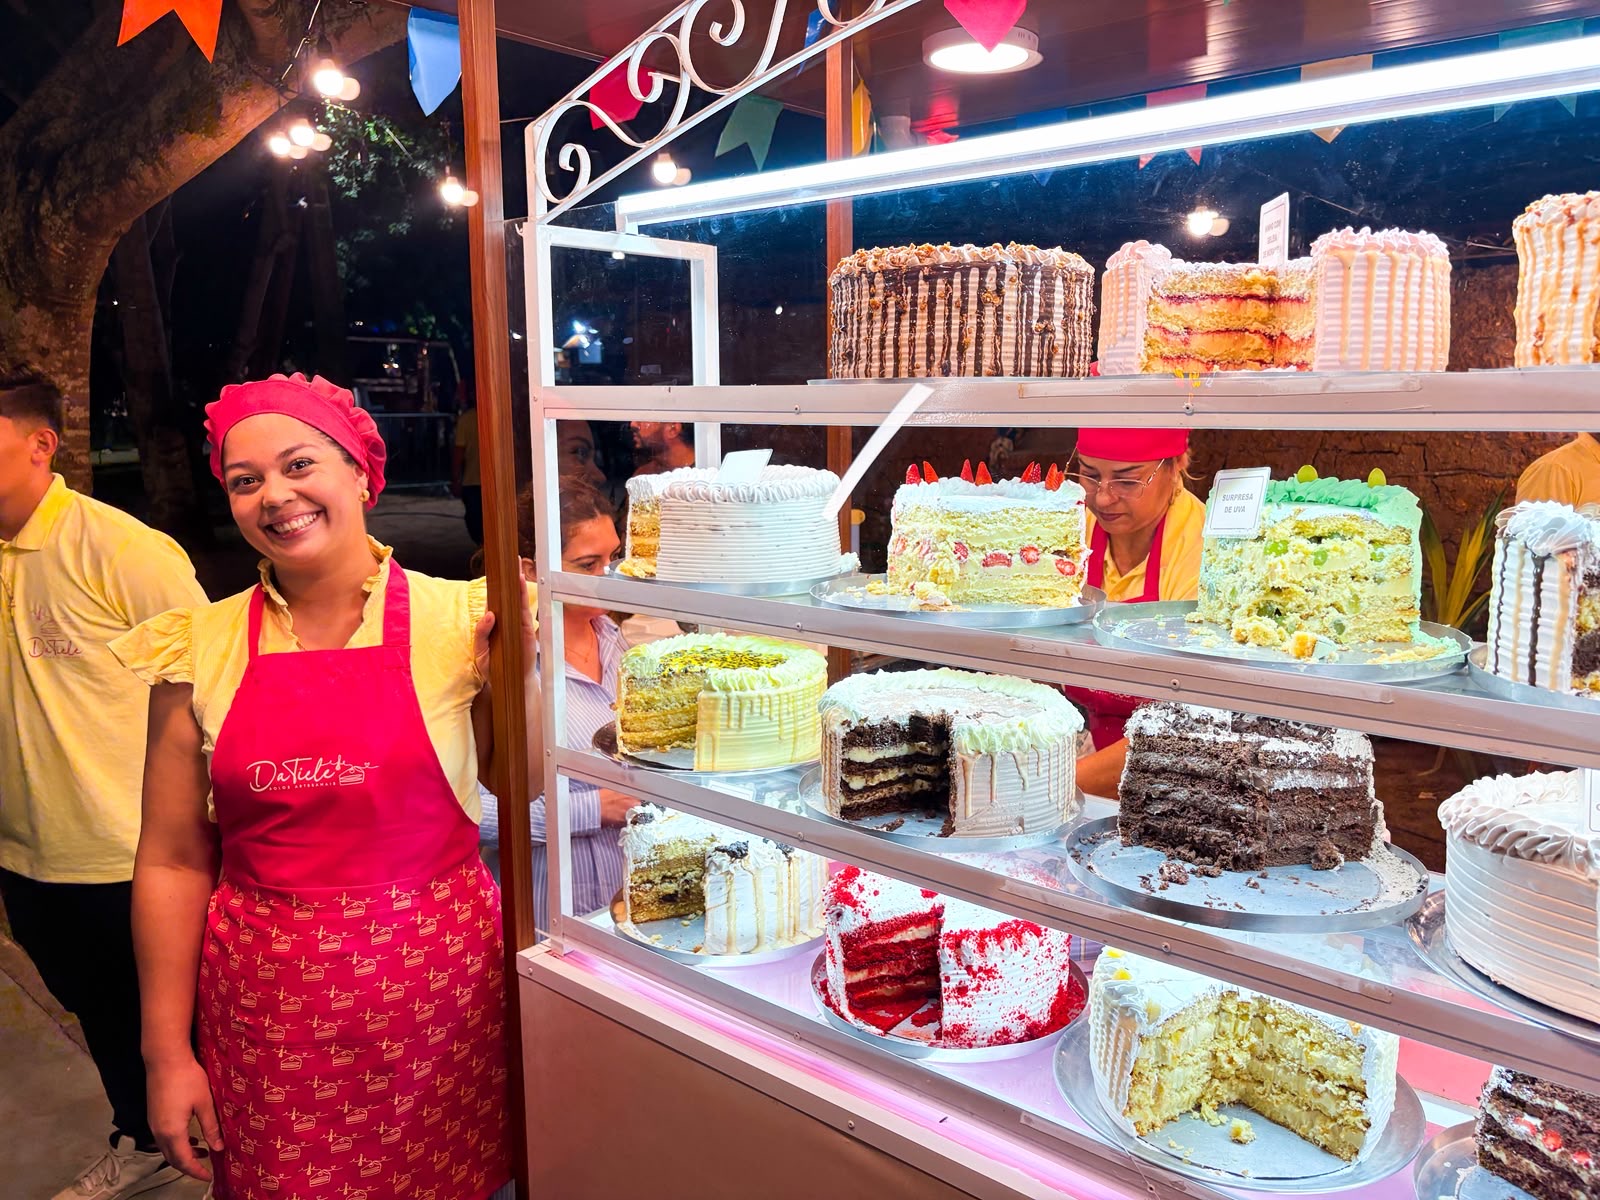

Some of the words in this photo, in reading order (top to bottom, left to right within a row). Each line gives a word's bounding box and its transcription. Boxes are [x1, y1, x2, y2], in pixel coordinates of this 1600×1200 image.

[1222, 493, 1254, 502] SURPRESA
[1233, 505, 1246, 513] UVA
[246, 756, 336, 792] DaTiele
